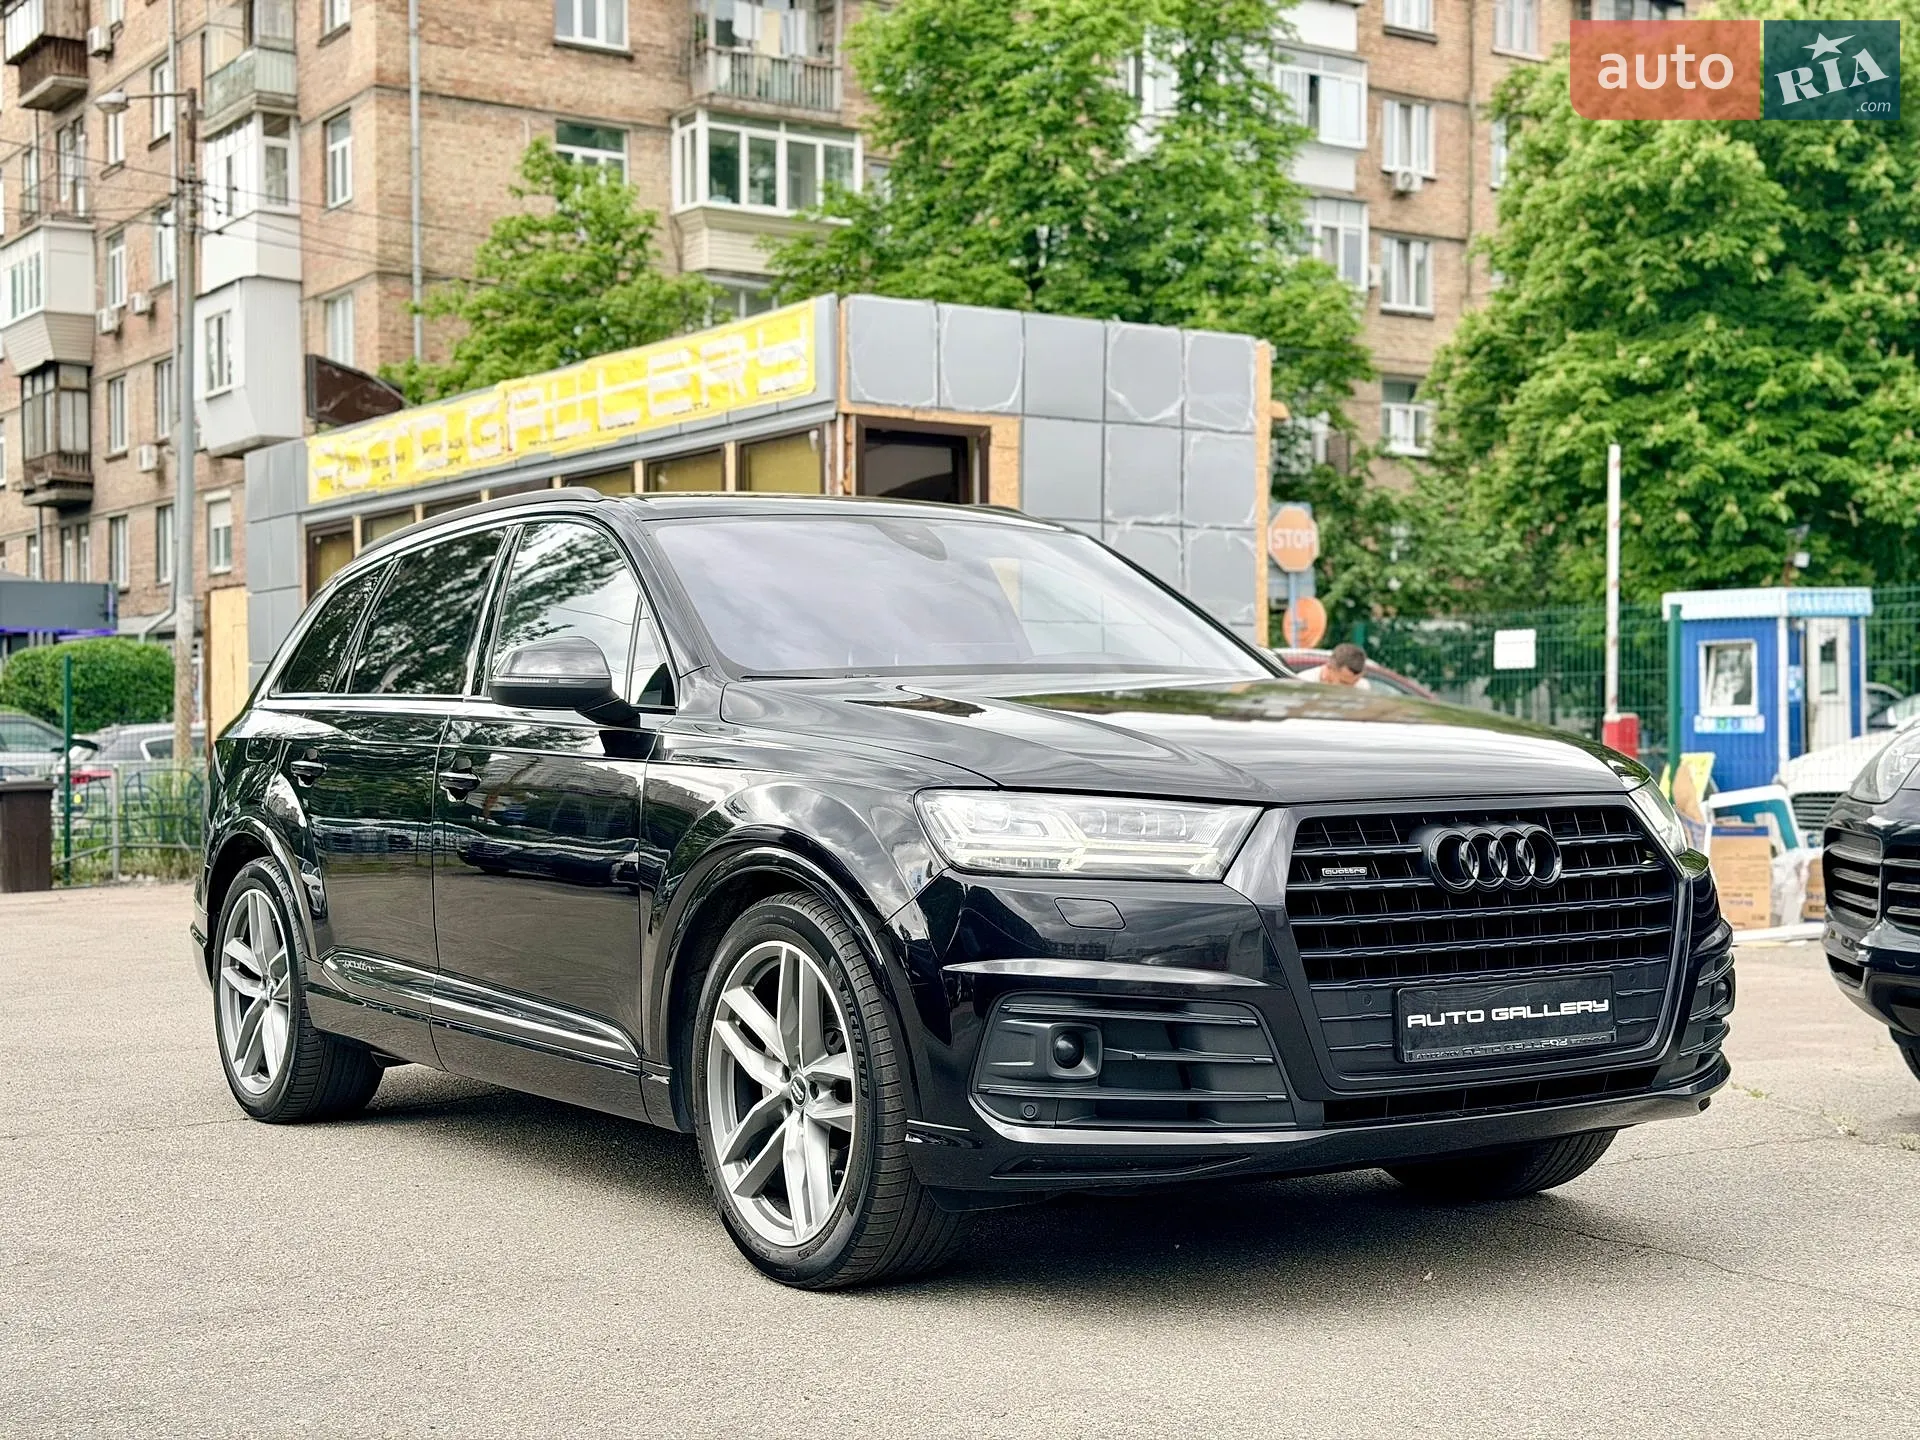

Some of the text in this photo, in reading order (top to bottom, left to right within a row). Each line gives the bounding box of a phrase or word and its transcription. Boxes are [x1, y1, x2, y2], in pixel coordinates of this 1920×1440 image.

[1273, 528, 1315, 548] STOP
[1407, 999, 1609, 1028] AUTO GALLERY
